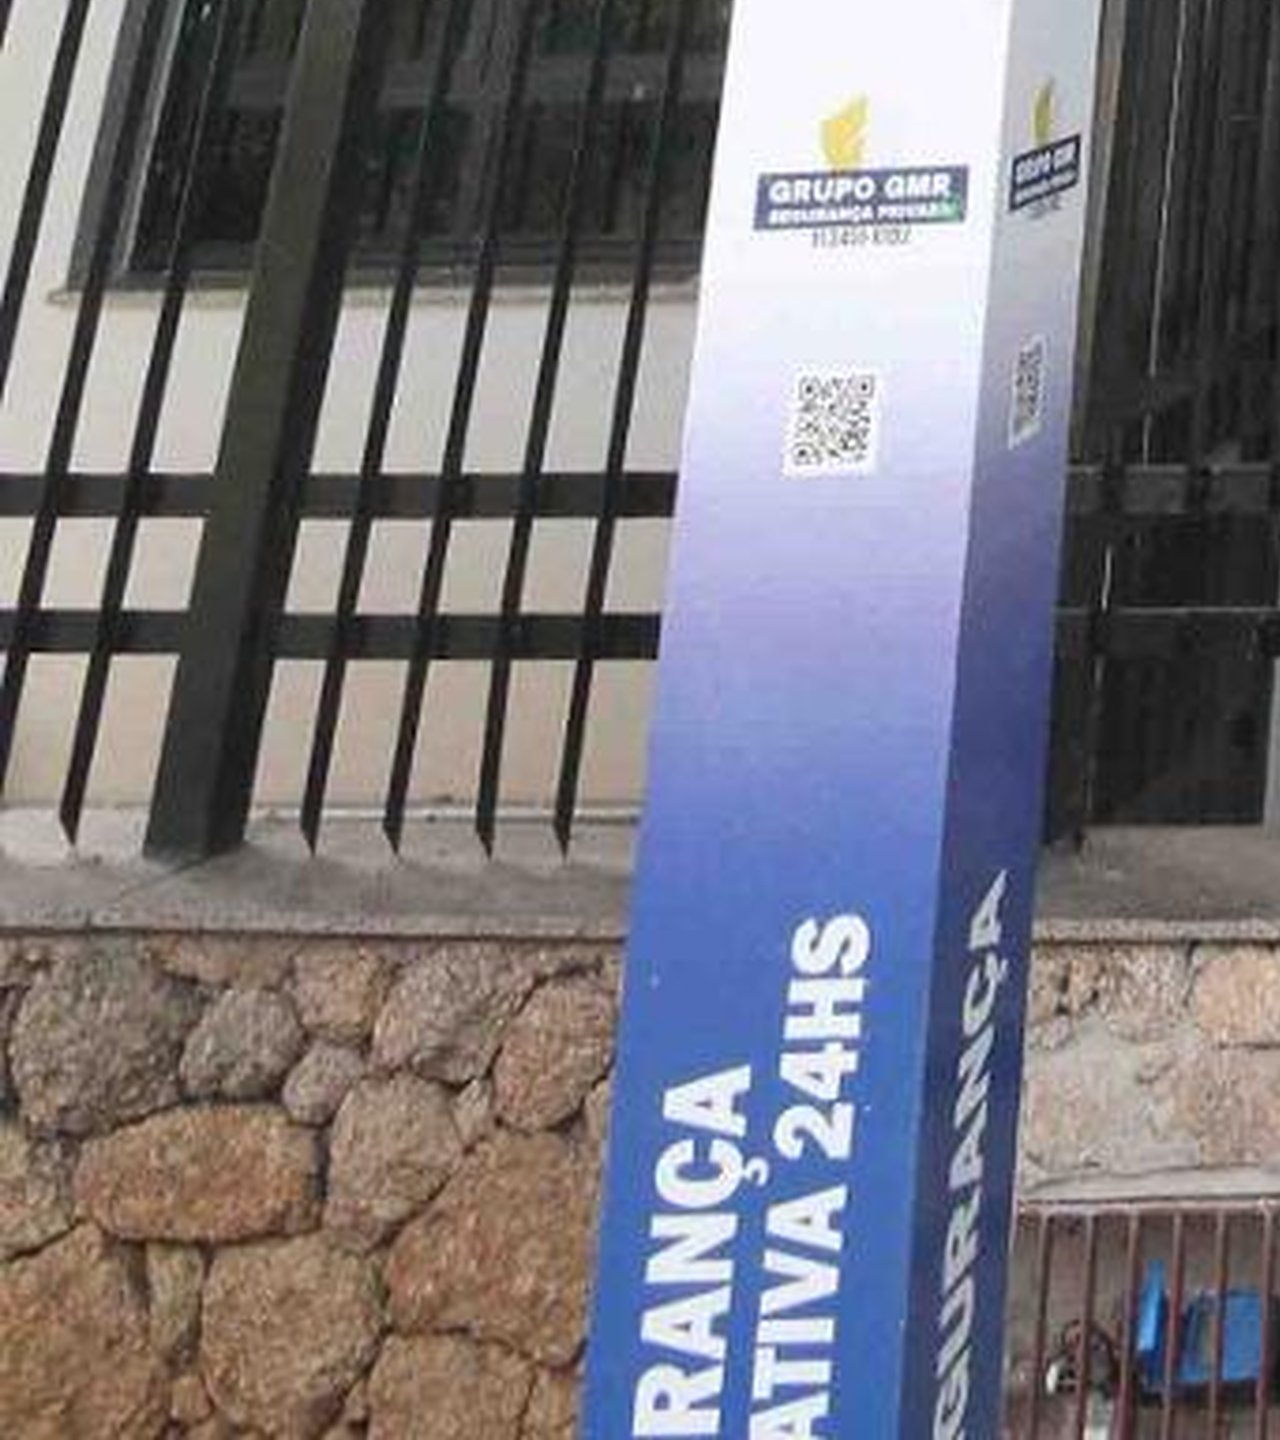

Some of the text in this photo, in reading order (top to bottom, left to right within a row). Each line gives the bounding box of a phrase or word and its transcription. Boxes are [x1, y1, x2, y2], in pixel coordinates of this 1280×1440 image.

[768, 174, 950, 203] GRUPO GMR
[773, 913, 871, 1161] 24HS
[932, 869, 1010, 1440] GURANÇA
